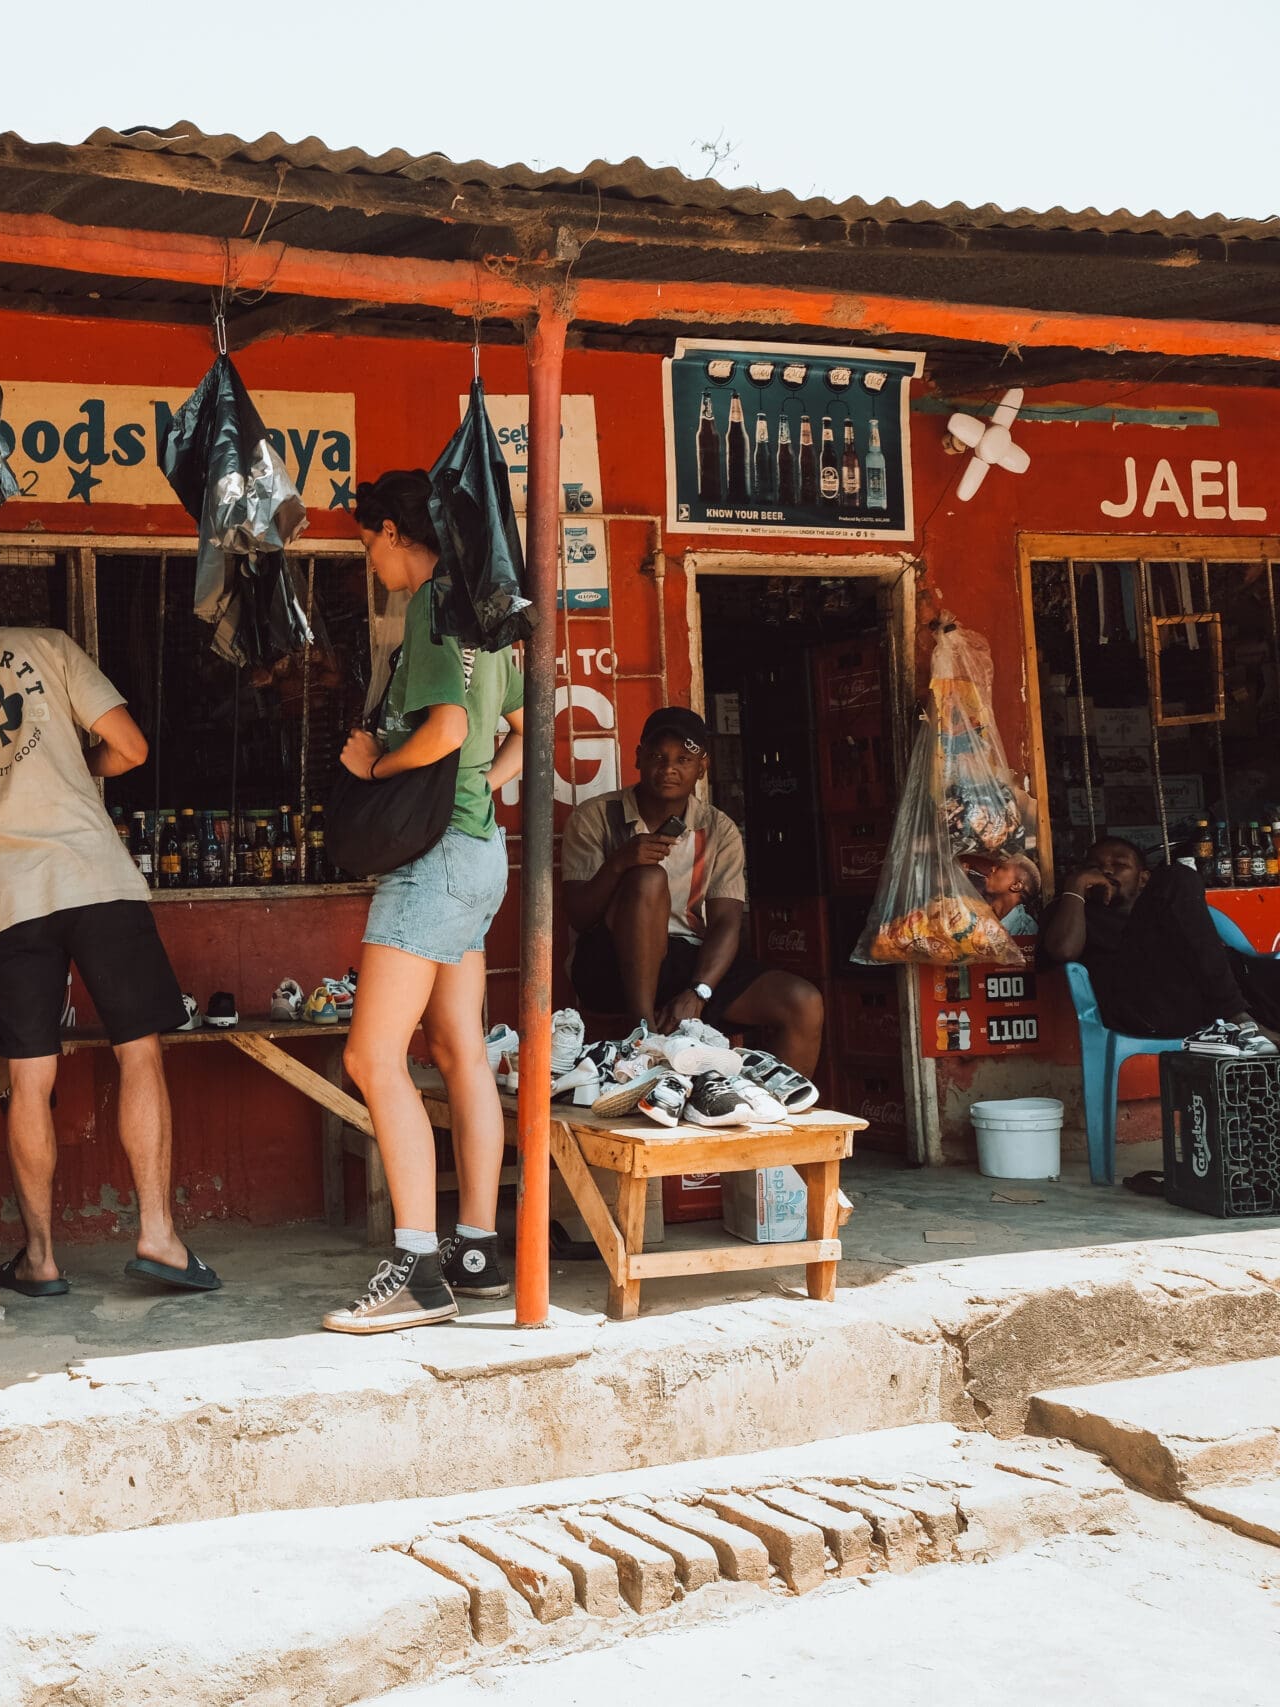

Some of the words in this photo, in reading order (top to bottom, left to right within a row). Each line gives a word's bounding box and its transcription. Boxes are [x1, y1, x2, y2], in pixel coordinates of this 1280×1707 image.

[1100, 456, 1267, 522] JAEL
[706, 508, 733, 519] KNOW
[734, 510, 759, 520] YOUR
[760, 511, 786, 521] BEER.
[14, 726, 42, 763] GOODS
[986, 976, 1025, 998] 900
[989, 1018, 1038, 1041] 1100
[1188, 1093, 1210, 1178] Carlsberg
[773, 1170, 788, 1224] splash
